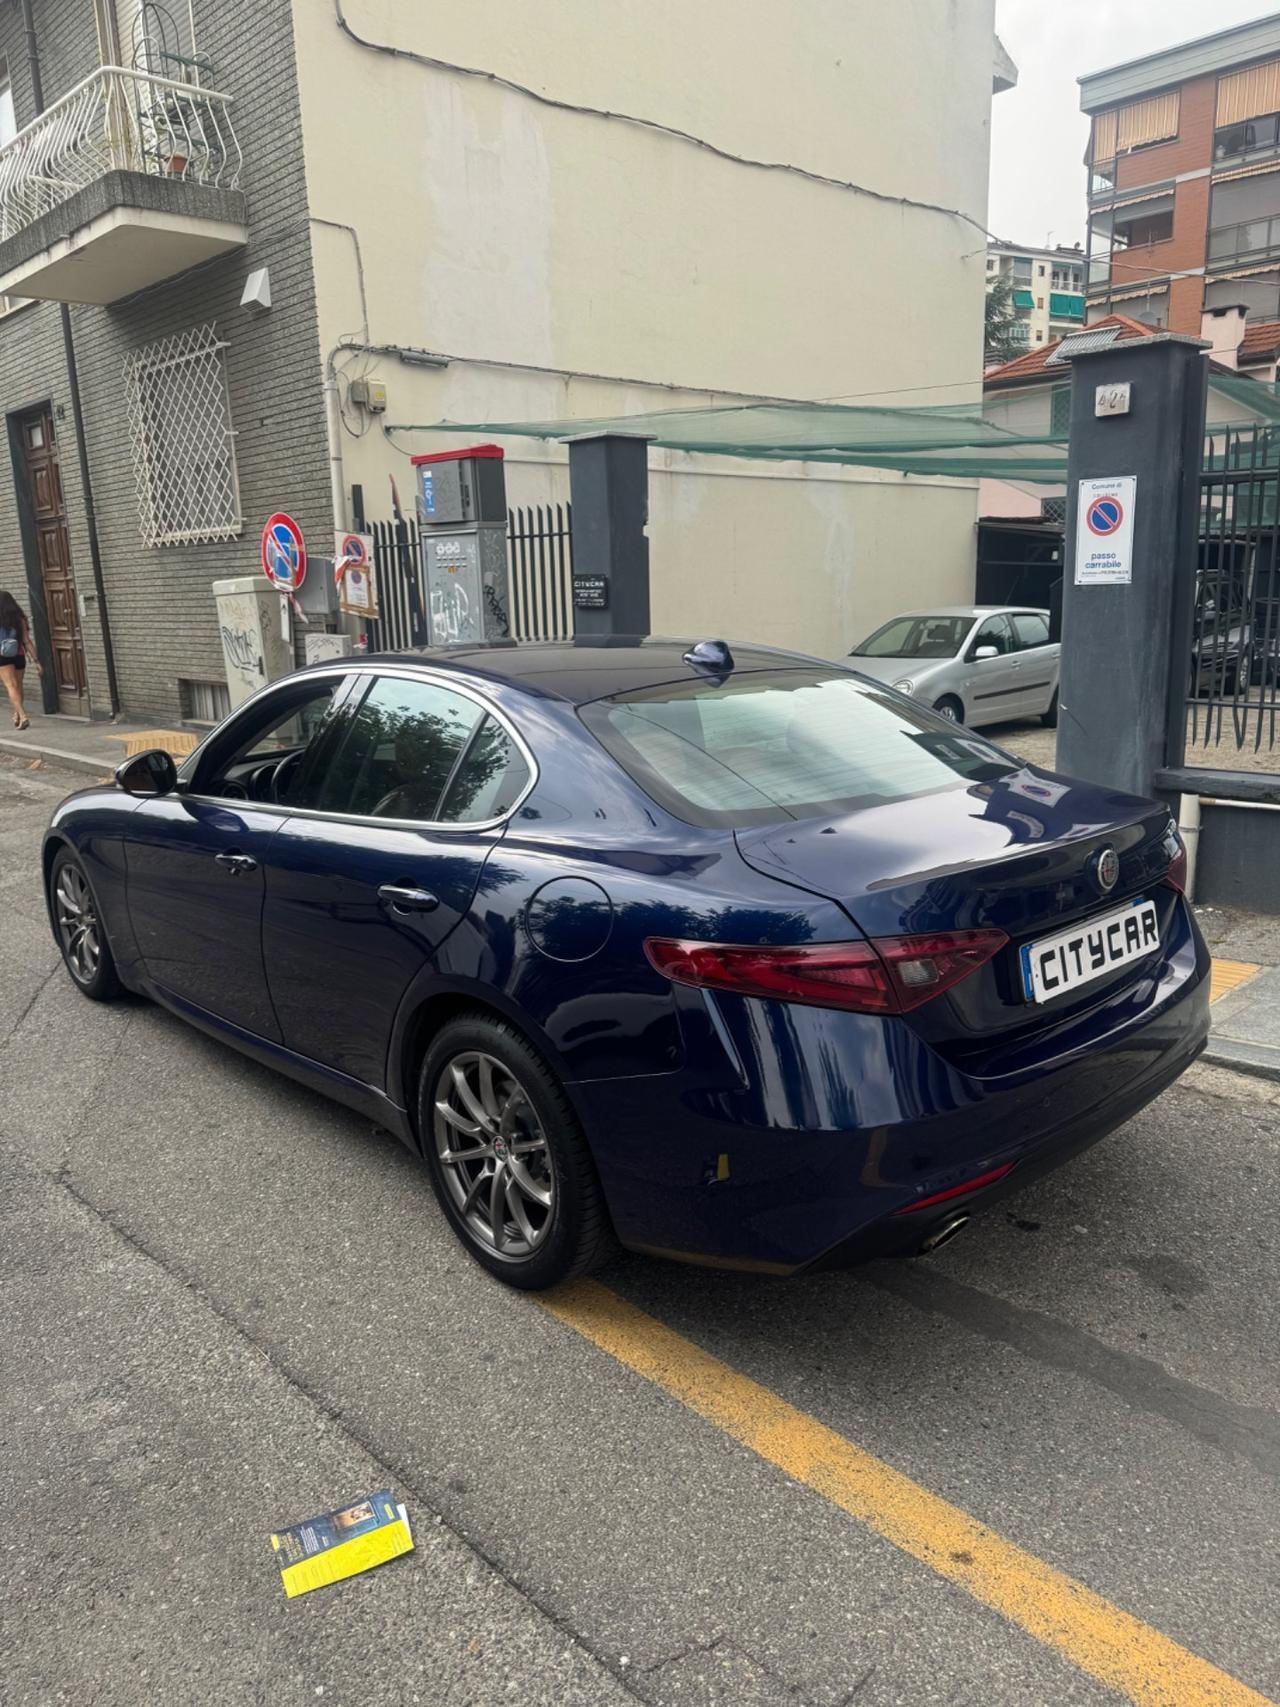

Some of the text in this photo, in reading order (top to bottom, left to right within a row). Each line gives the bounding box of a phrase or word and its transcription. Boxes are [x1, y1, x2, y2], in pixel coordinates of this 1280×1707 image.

[1091, 553, 1117, 561] passo
[1085, 561, 1122, 569] carrabile
[573, 580, 605, 588] CITYCAR
[1040, 909, 1157, 990] CITYCAR
